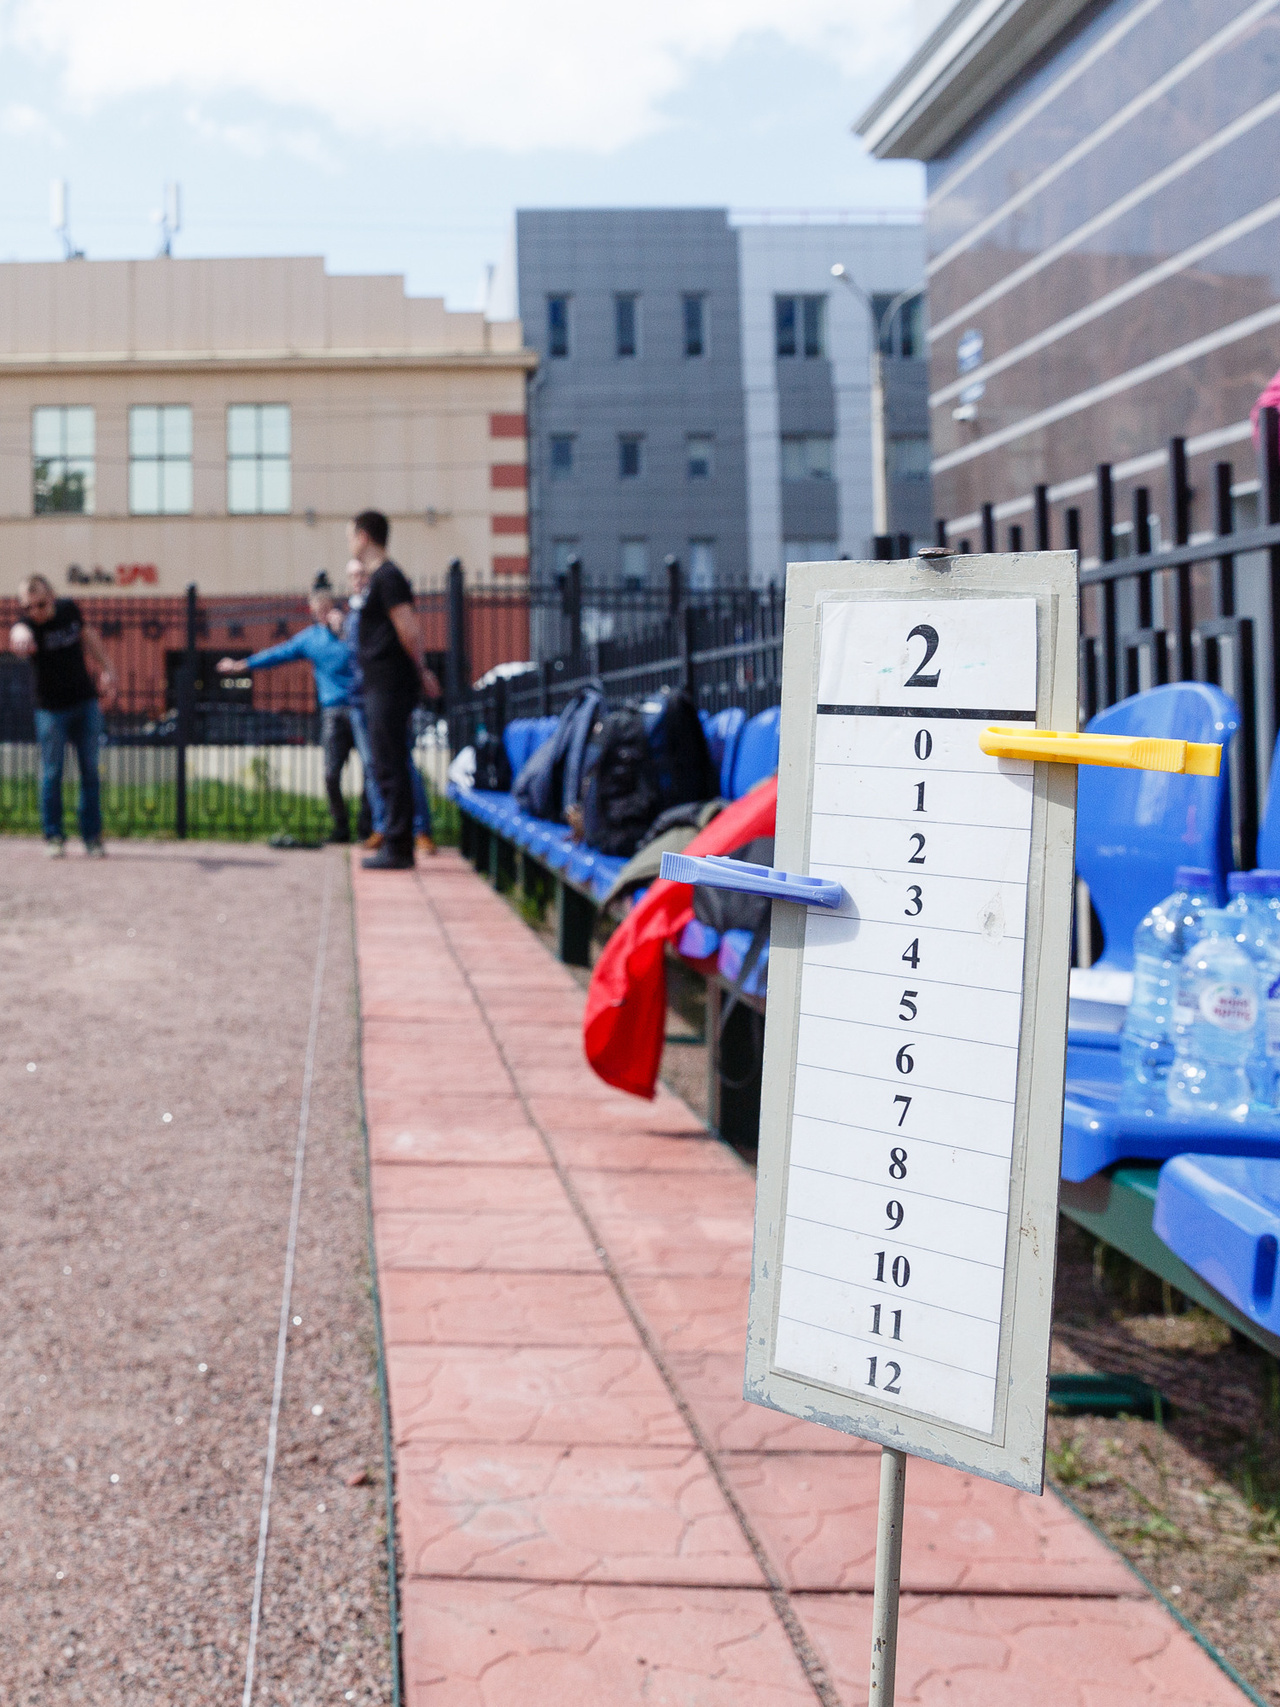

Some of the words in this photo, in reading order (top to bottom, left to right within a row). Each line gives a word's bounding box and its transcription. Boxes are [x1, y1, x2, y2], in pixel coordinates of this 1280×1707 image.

[904, 624, 941, 687] 2
[914, 729, 932, 760] 0
[913, 781, 927, 812] 1
[908, 833, 926, 864] 2
[905, 885, 922, 916] 3
[902, 938, 920, 969] 4
[899, 990, 918, 1021] 5
[896, 1044, 915, 1074] 6
[893, 1095, 912, 1126] 7
[889, 1148, 907, 1179] 8
[885, 1200, 904, 1230] 9
[874, 1251, 910, 1287] 10
[870, 1304, 902, 1341] 11
[867, 1356, 901, 1394] 12
